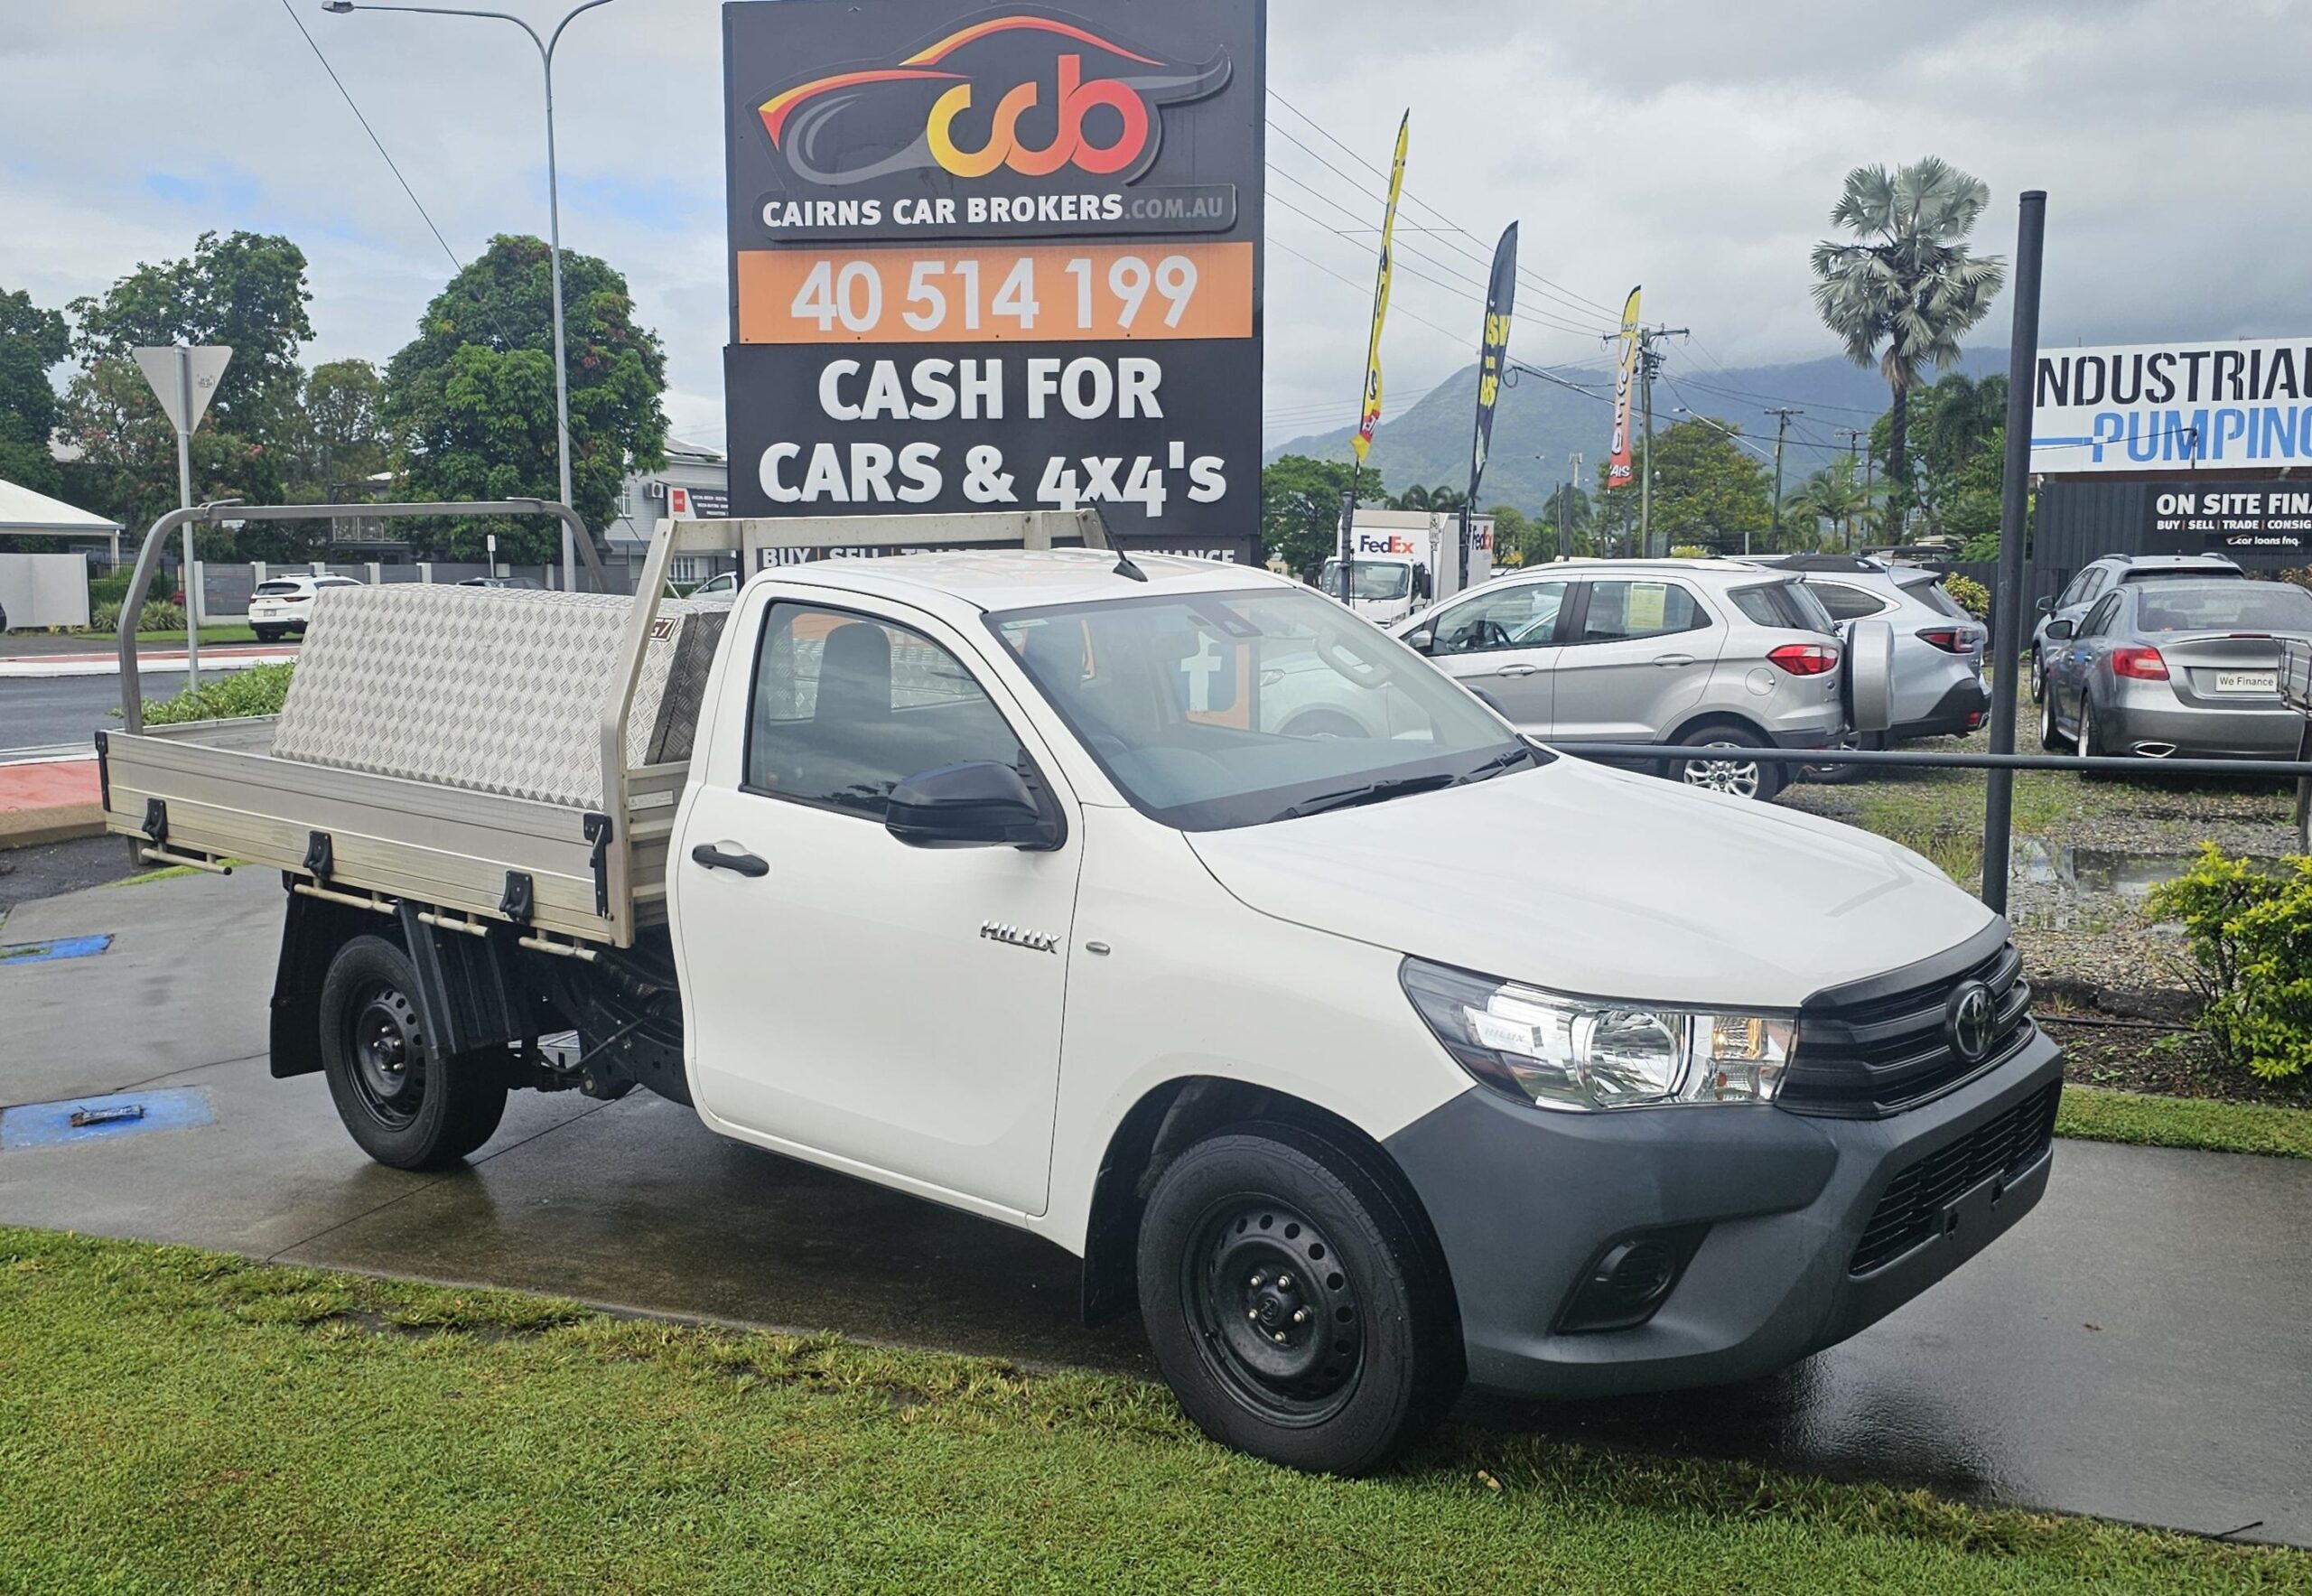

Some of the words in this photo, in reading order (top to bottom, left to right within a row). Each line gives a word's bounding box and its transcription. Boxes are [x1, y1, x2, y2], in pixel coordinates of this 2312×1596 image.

[762, 200, 881, 227] CAIRNS
[892, 199, 956, 225] CAR
[791, 260, 882, 331] 40
[902, 257, 1039, 331] 514
[1065, 255, 1198, 329] 199
[818, 358, 1003, 421] CASH
[1028, 357, 1164, 419] FOR
[759, 442, 943, 502] CARS
[963, 444, 1019, 503] &
[2156, 493, 2195, 516] ON
[2202, 493, 2261, 515] SITE
[2268, 493, 2312, 515] FIN
[2157, 519, 2181, 530] BUY
[2187, 519, 2215, 530] SELL
[2222, 519, 2259, 530] TRADE
[1359, 535, 1415, 555] FedEx
[2254, 536, 2281, 546] loans
[762, 548, 811, 567] BUY
[2219, 676, 2234, 686] We
[2236, 676, 2274, 686] Finance
[980, 919, 1062, 955] HILUX
